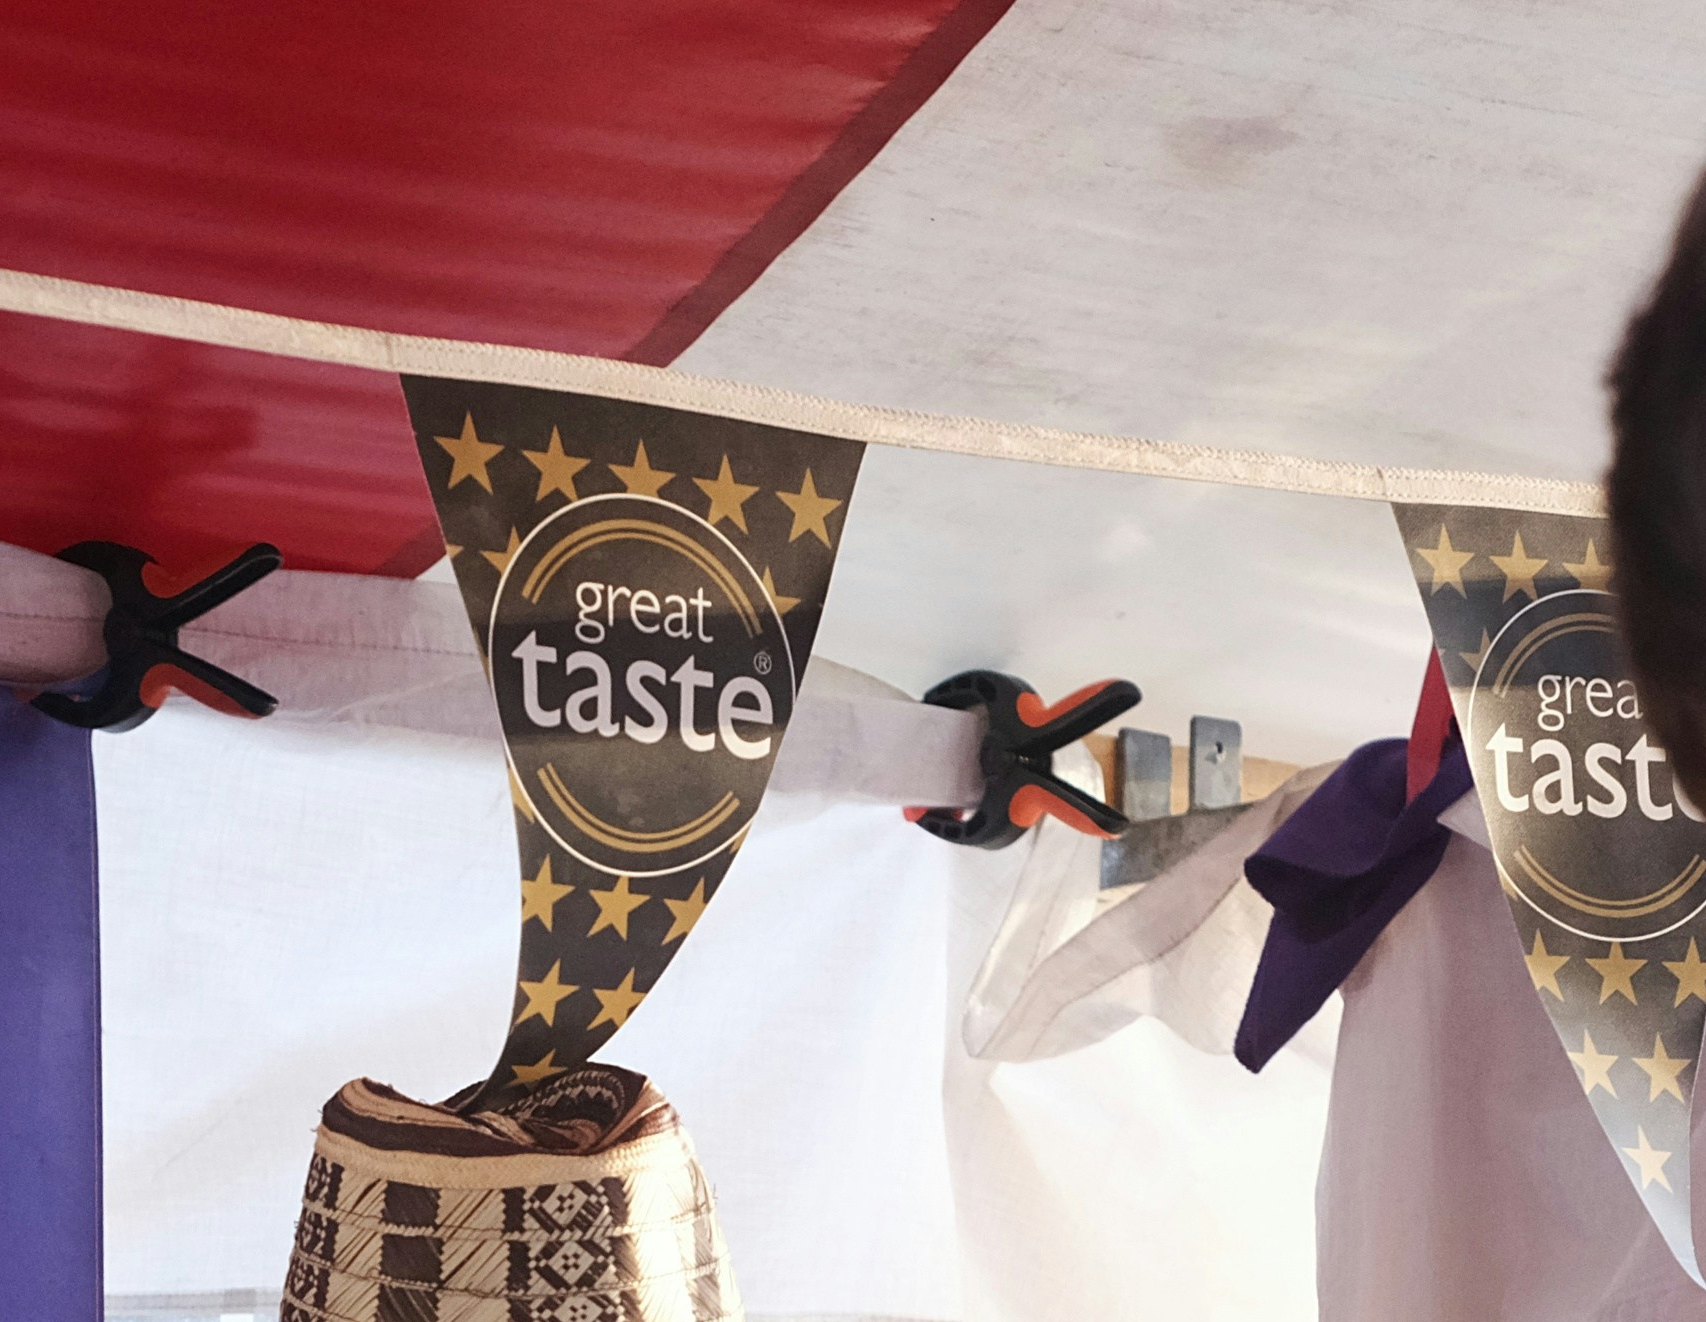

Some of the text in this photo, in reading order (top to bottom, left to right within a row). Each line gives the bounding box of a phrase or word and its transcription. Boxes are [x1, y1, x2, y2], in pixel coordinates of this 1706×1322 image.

[575, 581, 714, 644] great
[510, 630, 774, 760] taste
[1536, 673, 1645, 731] grea
